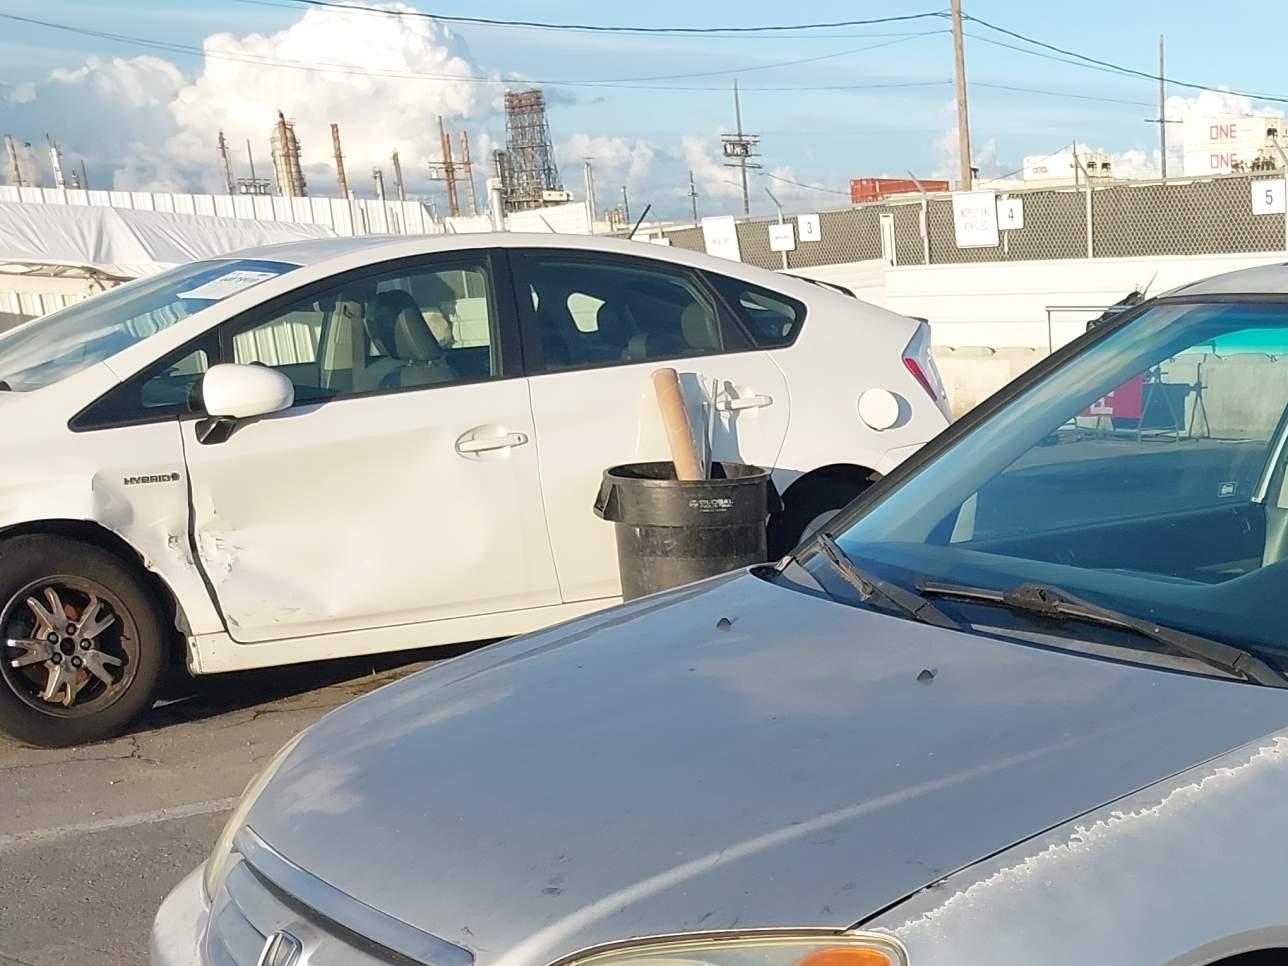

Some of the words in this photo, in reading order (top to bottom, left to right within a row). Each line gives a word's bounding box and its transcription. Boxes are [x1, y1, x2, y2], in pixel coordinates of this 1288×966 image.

[1210, 124, 1237, 140] ONE
[1210, 153, 1238, 169] ONE
[1265, 189, 1273, 206] 5
[1008, 207, 1015, 222] 4
[807, 221, 813, 234] 3
[123, 474, 172, 485] HYBRID
